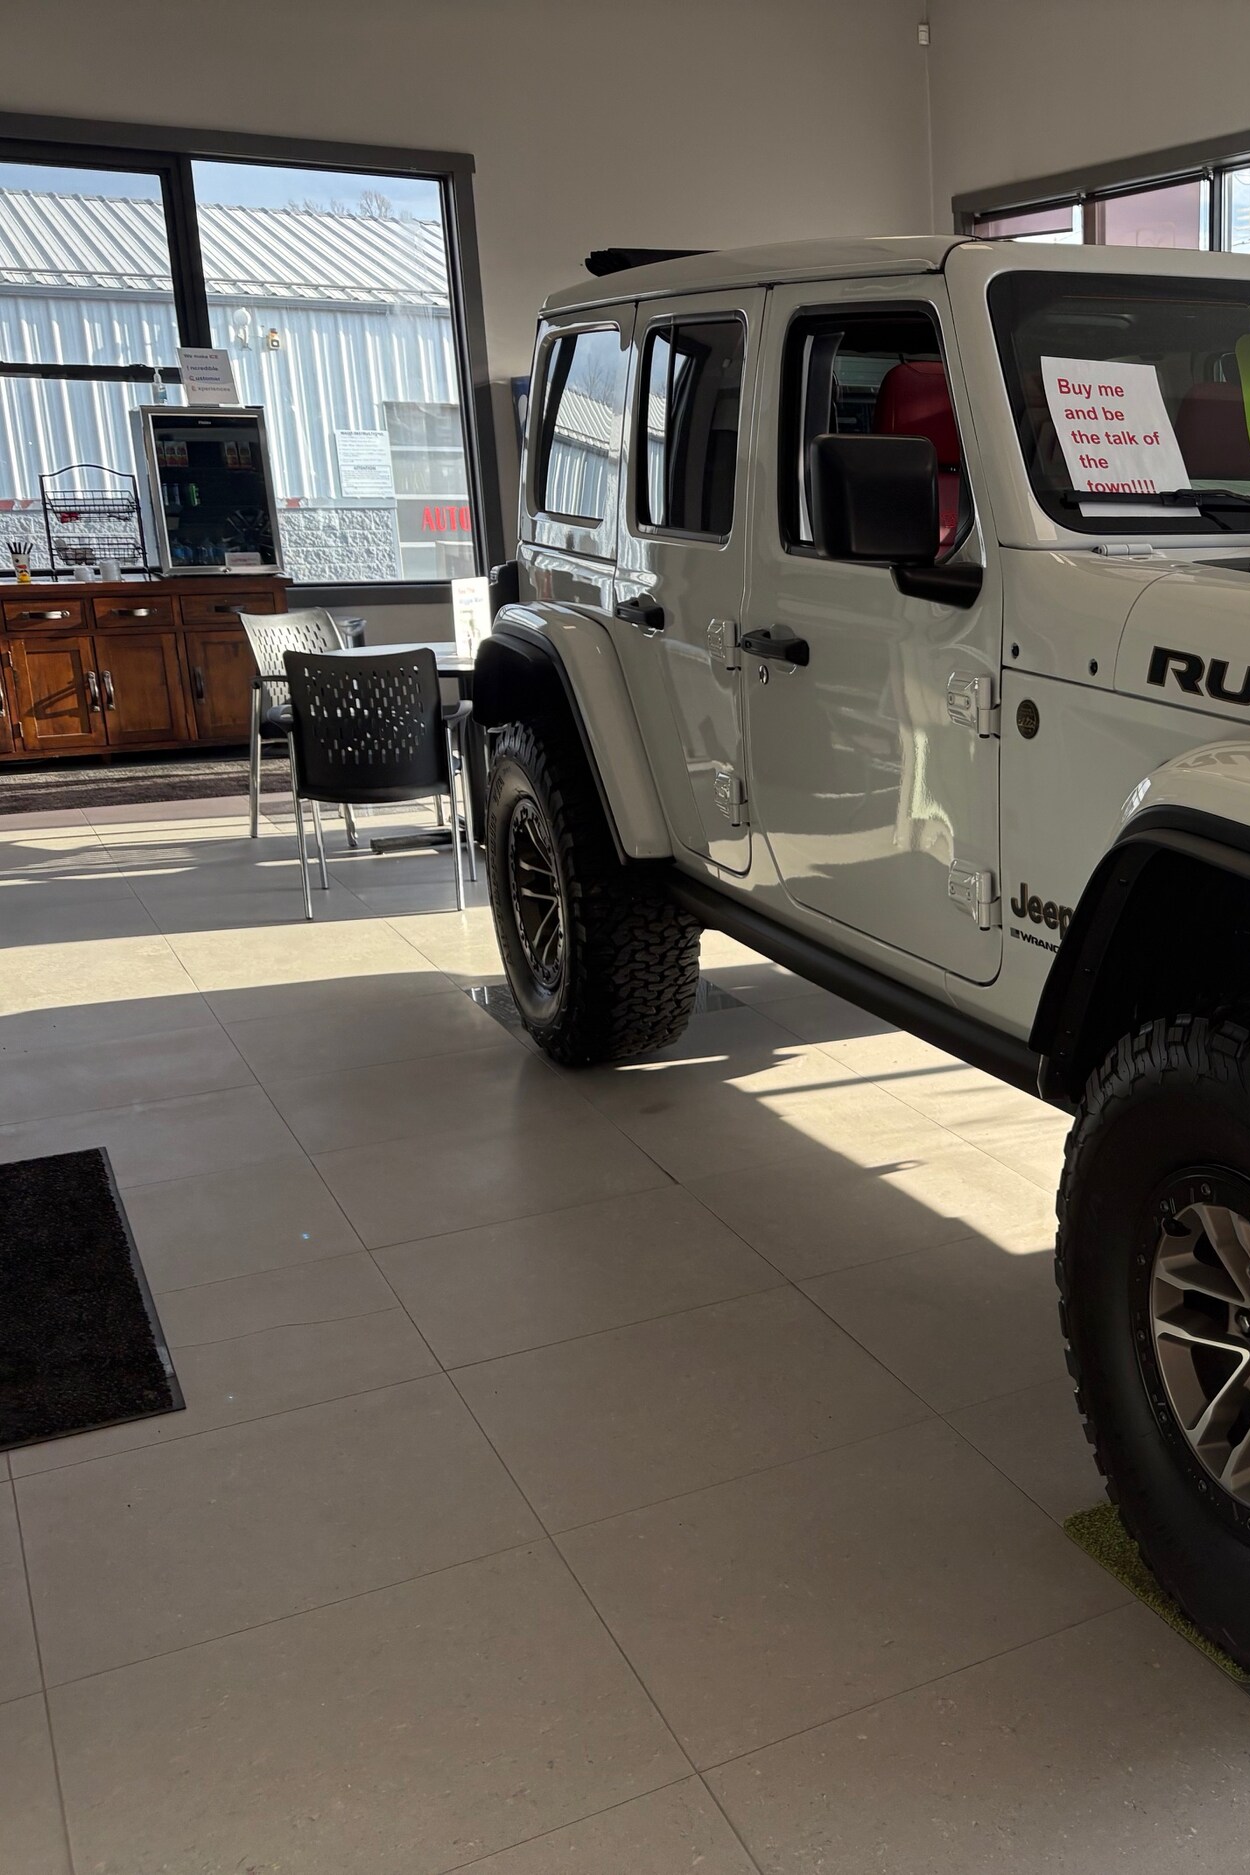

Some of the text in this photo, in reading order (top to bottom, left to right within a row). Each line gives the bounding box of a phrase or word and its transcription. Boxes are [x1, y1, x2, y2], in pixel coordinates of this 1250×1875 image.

[1057, 377, 1125, 400] Buy me
[1063, 406, 1125, 421] and be
[1070, 429, 1161, 446] the talk of
[1078, 454, 1109, 470] the
[1086, 479, 1157, 495] town!!!!
[421, 504, 472, 533] AUTO
[1010, 881, 1075, 941] Jeep
